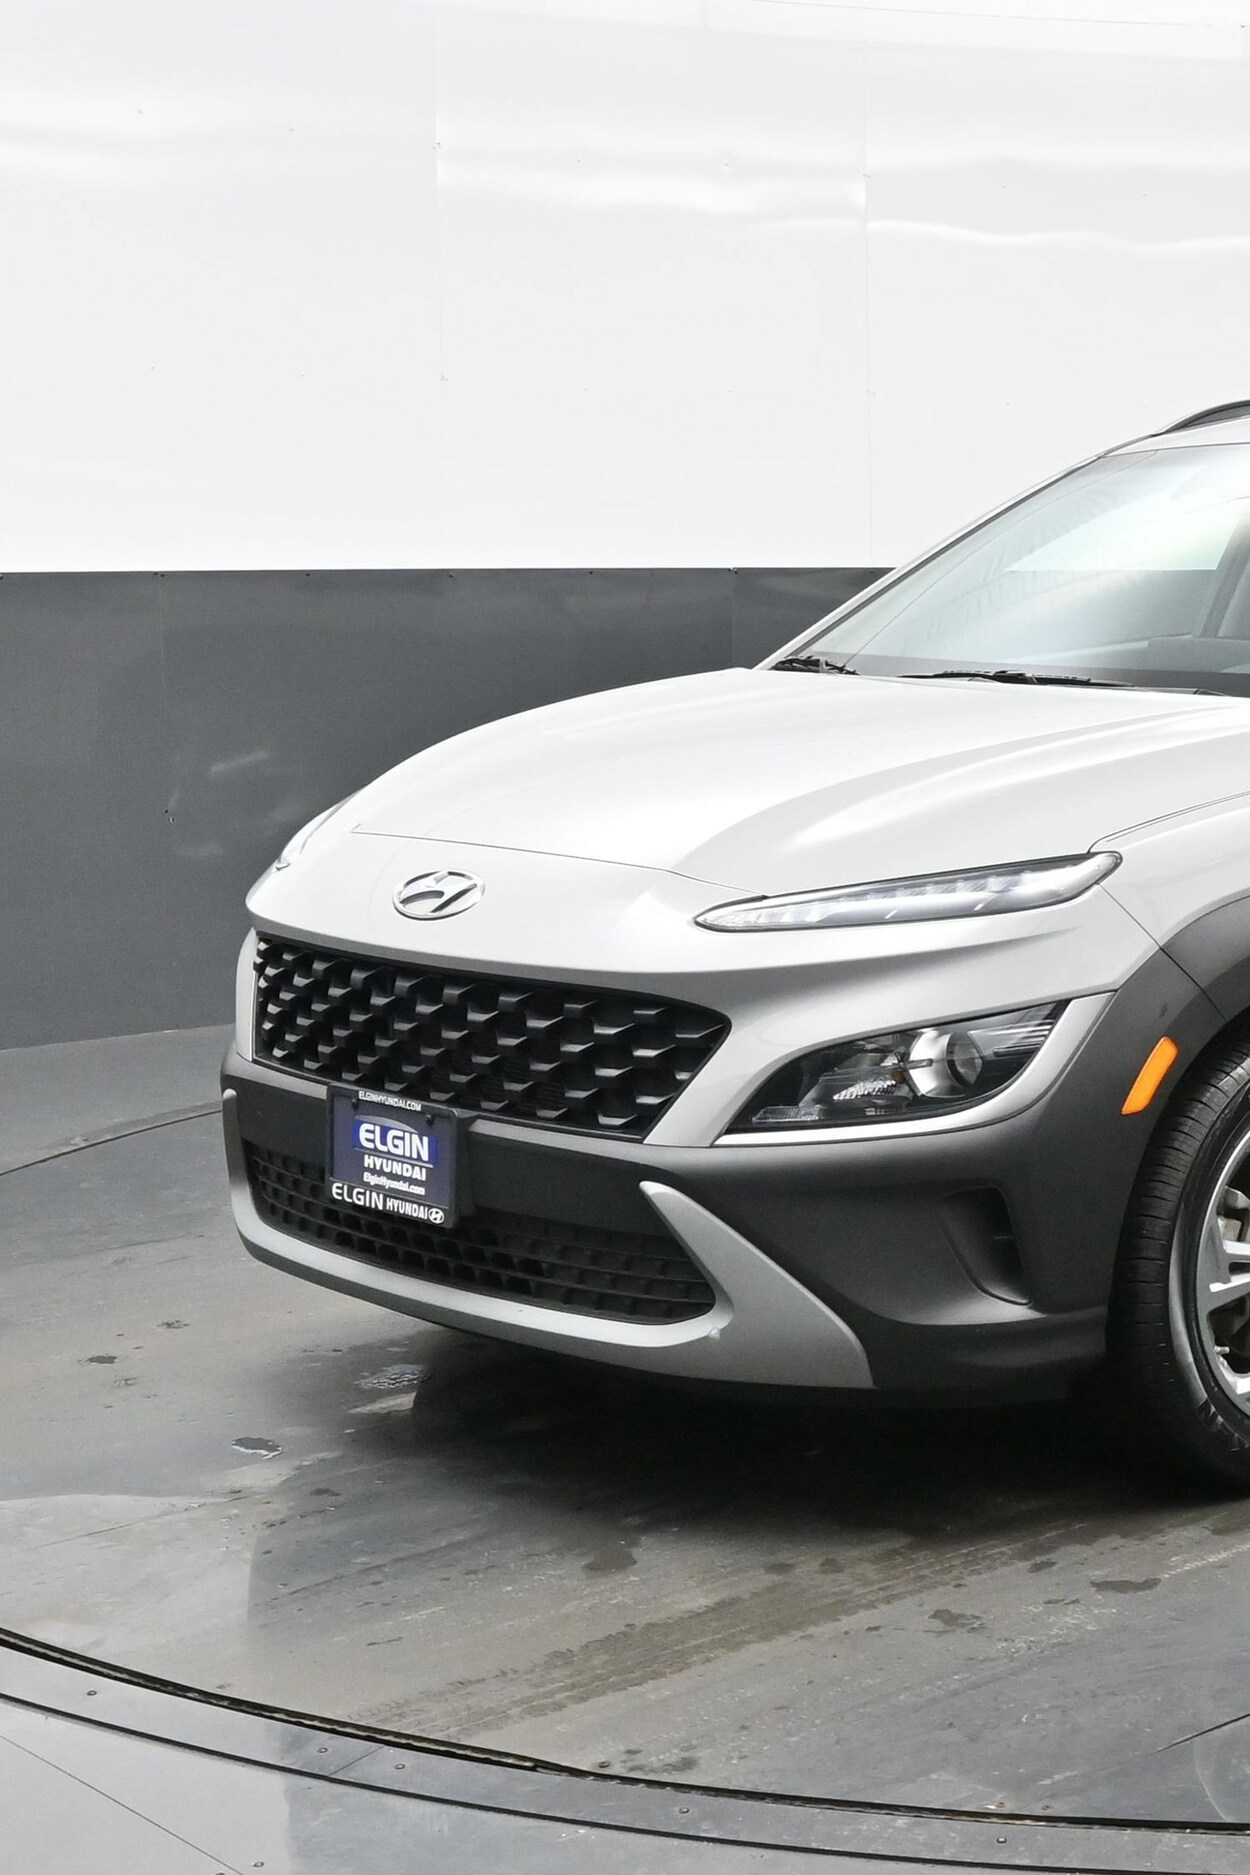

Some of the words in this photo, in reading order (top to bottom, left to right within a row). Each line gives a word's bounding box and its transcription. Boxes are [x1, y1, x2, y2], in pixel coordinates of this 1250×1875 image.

[359, 1123, 429, 1161] ELGIN
[364, 1155, 426, 1181] HYUNDAI
[332, 1183, 383, 1210] ELGIN
[386, 1197, 428, 1219] HYUNDAI
